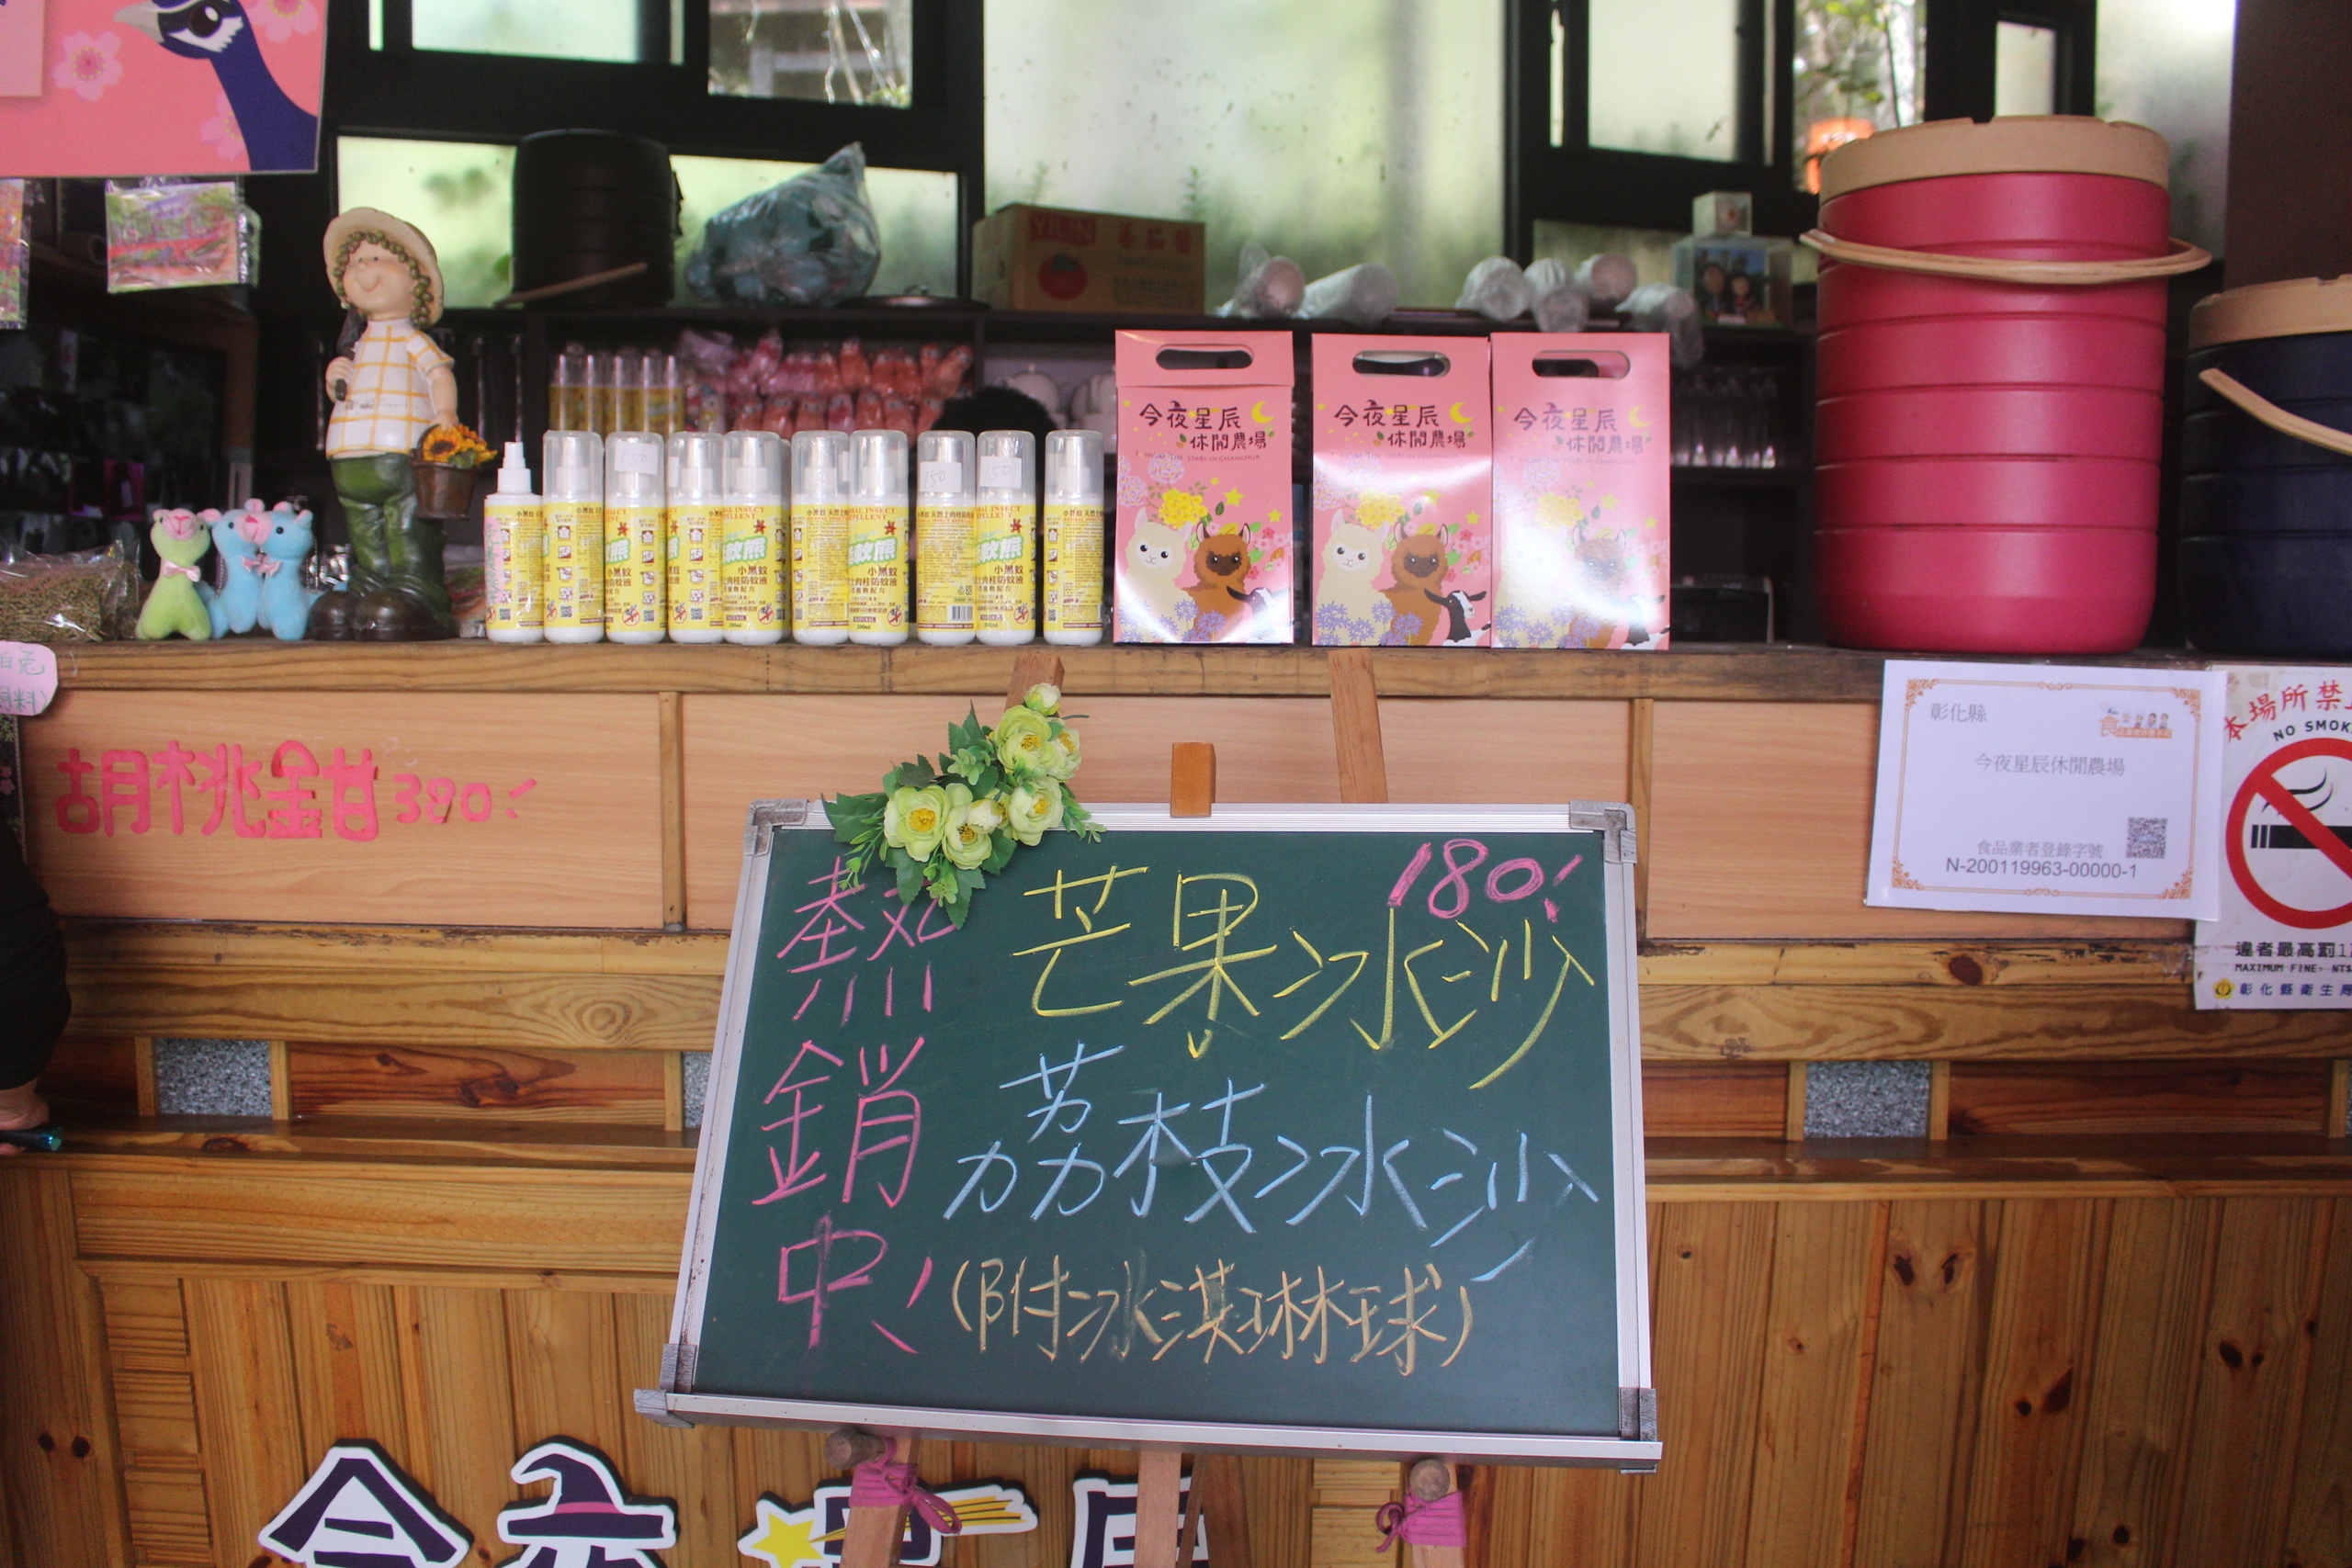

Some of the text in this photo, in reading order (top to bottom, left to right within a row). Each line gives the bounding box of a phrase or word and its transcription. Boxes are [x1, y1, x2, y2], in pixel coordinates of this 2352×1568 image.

[1139, 400, 1241, 430] 今夜星辰
[1334, 399, 1439, 427] 今夜星辰
[1513, 402, 1617, 432] 今夜星辰
[1190, 431, 1267, 451] 休閒農場
[1387, 430, 1465, 449] 休閒農場
[738, 565, 768, 576] 小黑蚊
[867, 566, 899, 577] 小黑蚊
[994, 564, 1024, 575] 小黑蚊
[1930, 703, 1987, 723] 彰化縣
[2224, 680, 2352, 742] 本場所禁
[2273, 719, 2352, 741] NO SMOK
[1975, 752, 2126, 777] 今夜星辰休閒農場
[1977, 839, 2104, 860] 食品業者登錄字號
[1945, 857, 2138, 879] N-200119963-00000-1
[2235, 942, 2352, 958] 違者最高罰1
[1012, 863, 1595, 1090] 芒果冰沙
[2234, 964, 2284, 973] MAXIMUM
